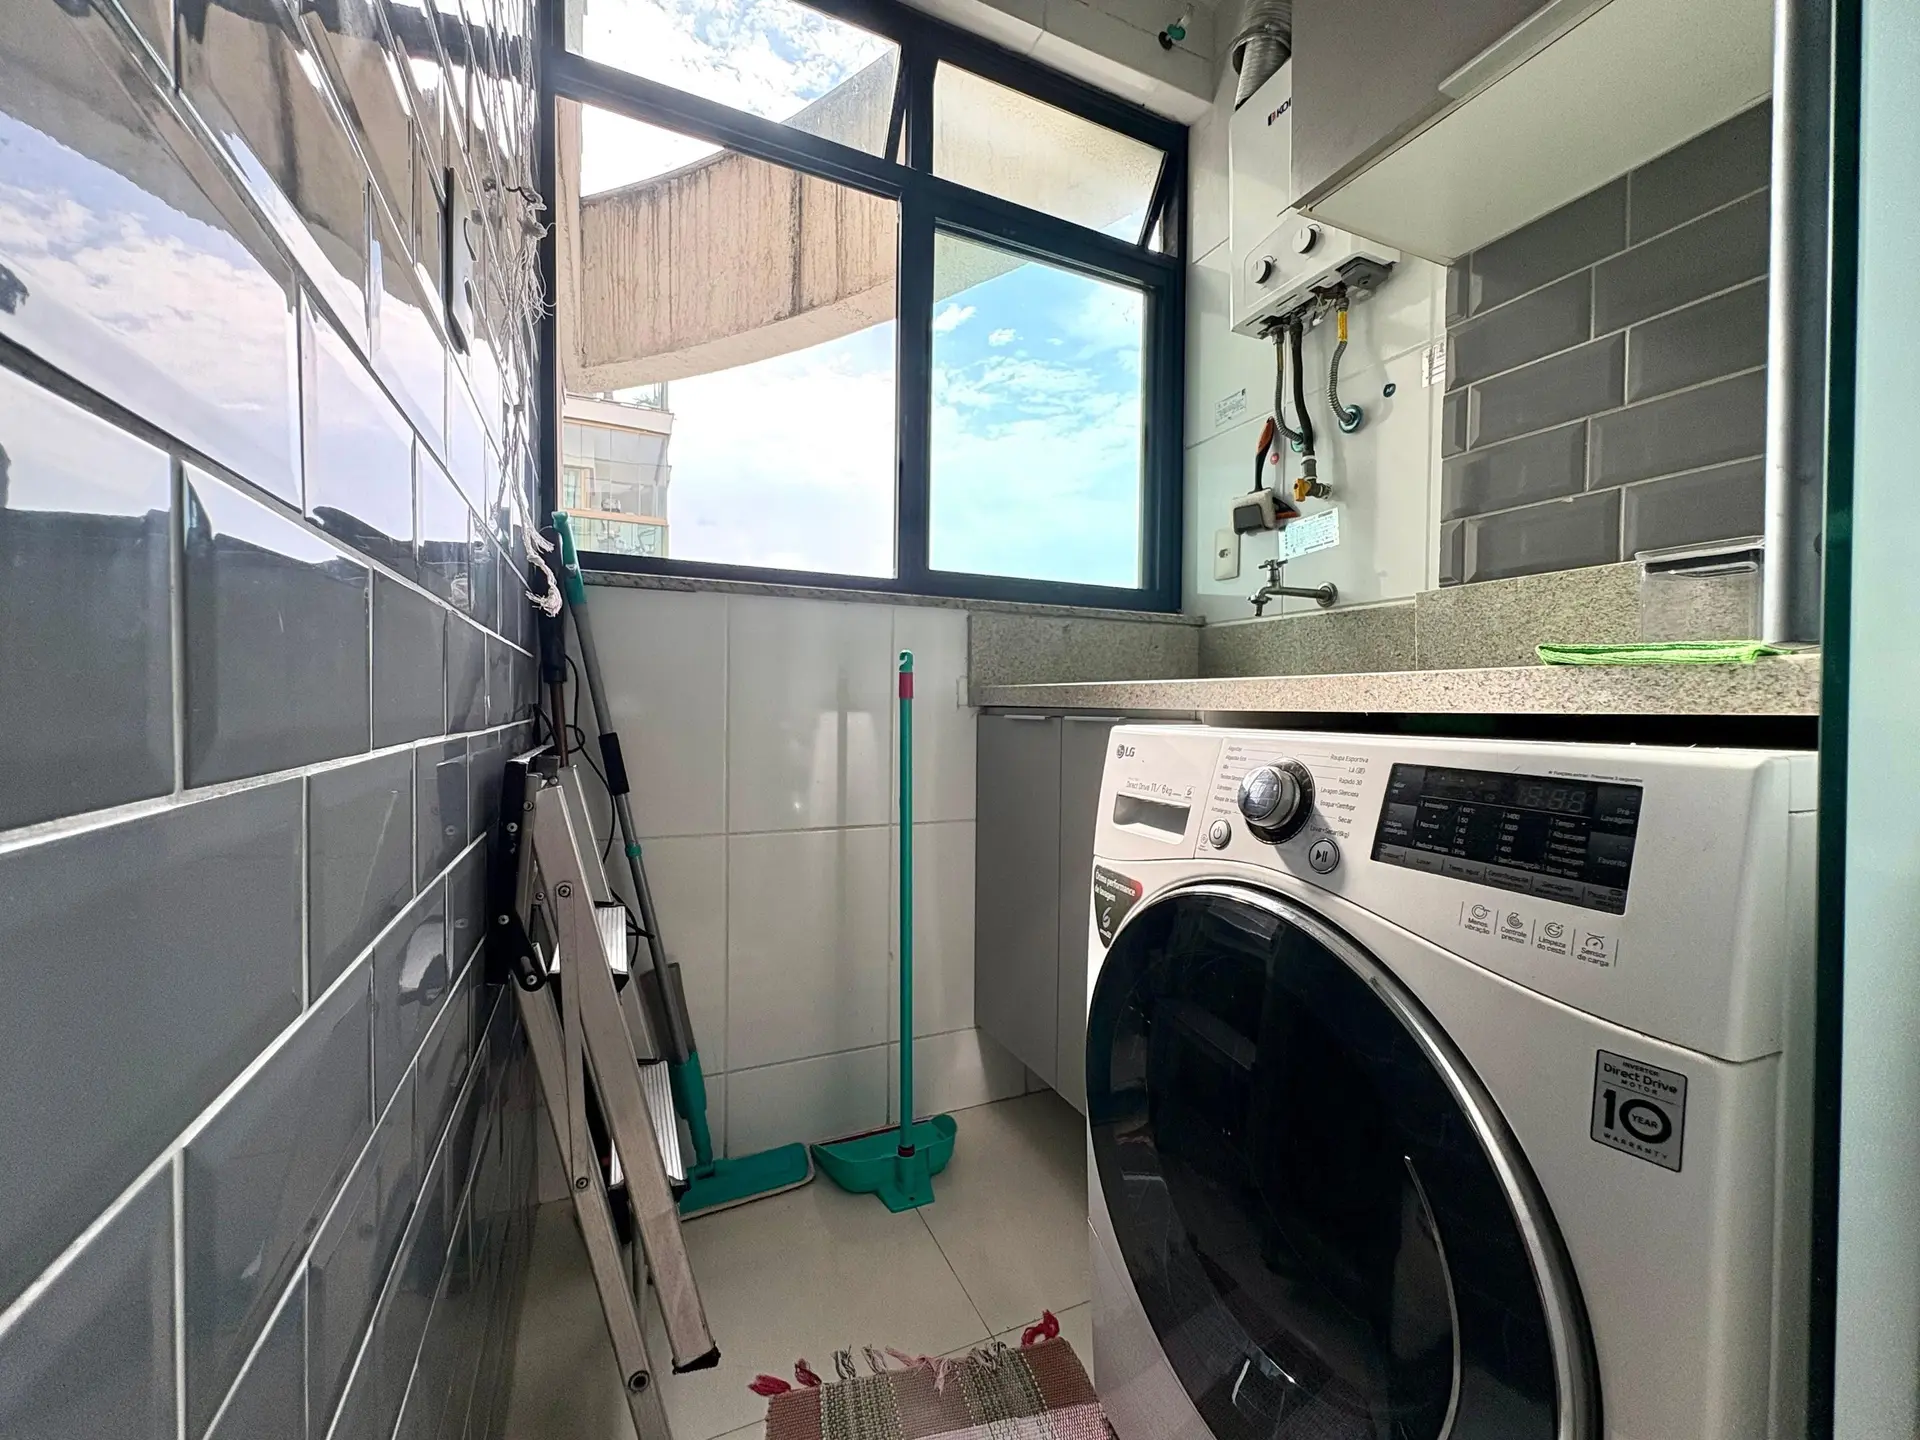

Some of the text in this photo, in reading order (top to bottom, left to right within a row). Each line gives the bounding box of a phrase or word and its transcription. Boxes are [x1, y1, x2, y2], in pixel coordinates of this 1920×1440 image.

[1337, 816, 1353, 825] Secar
[1464, 923, 1490, 935] vibração
[1468, 917, 1488, 928] Menos
[1501, 926, 1527, 939] Controle
[1538, 936, 1567, 949] Limpeza
[1581, 947, 1607, 959] Sensor
[1577, 953, 1610, 968] de carga
[1604, 1062, 1678, 1095] Direct Drive
[1621, 1079, 1658, 1095] MOTOR
[1603, 1088, 1672, 1145] 10
[1631, 1113, 1659, 1130] YEAR
[1603, 1132, 1668, 1160] WARRANTY
